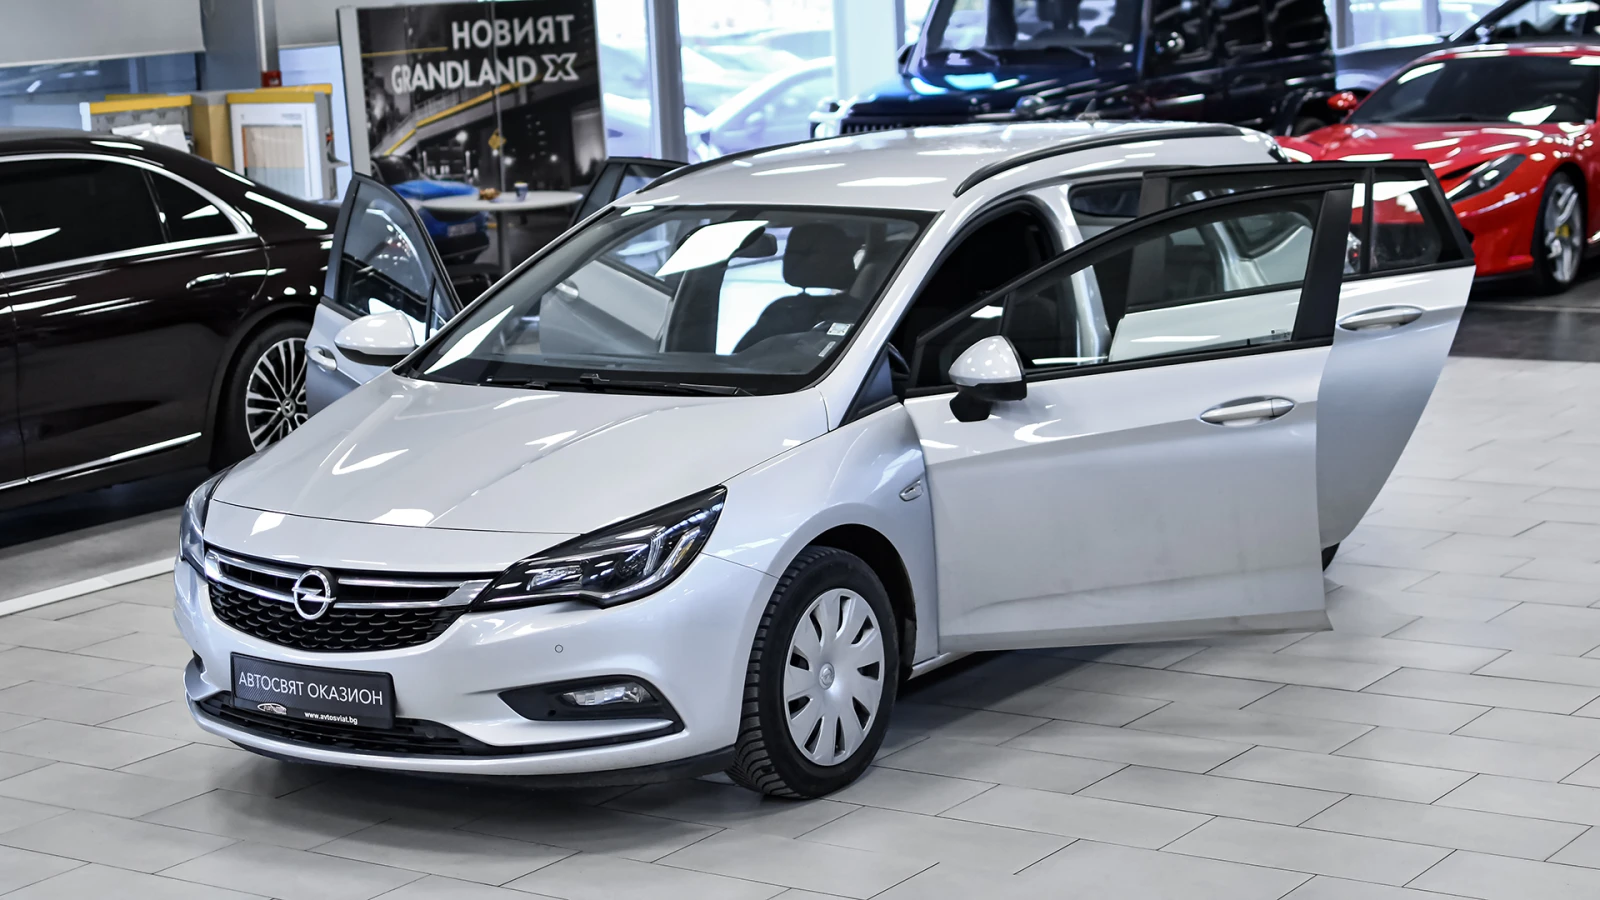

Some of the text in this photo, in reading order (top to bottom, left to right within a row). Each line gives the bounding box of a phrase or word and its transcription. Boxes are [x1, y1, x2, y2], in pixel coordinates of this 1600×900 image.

[451, 15, 574, 50] НОВИЯТ
[391, 53, 579, 95] GRANDLAND X
[239, 672, 383, 705] АВТОСВЯТ ОКАЗИОН
[304, 711, 358, 725] www.avtosviat.bg
